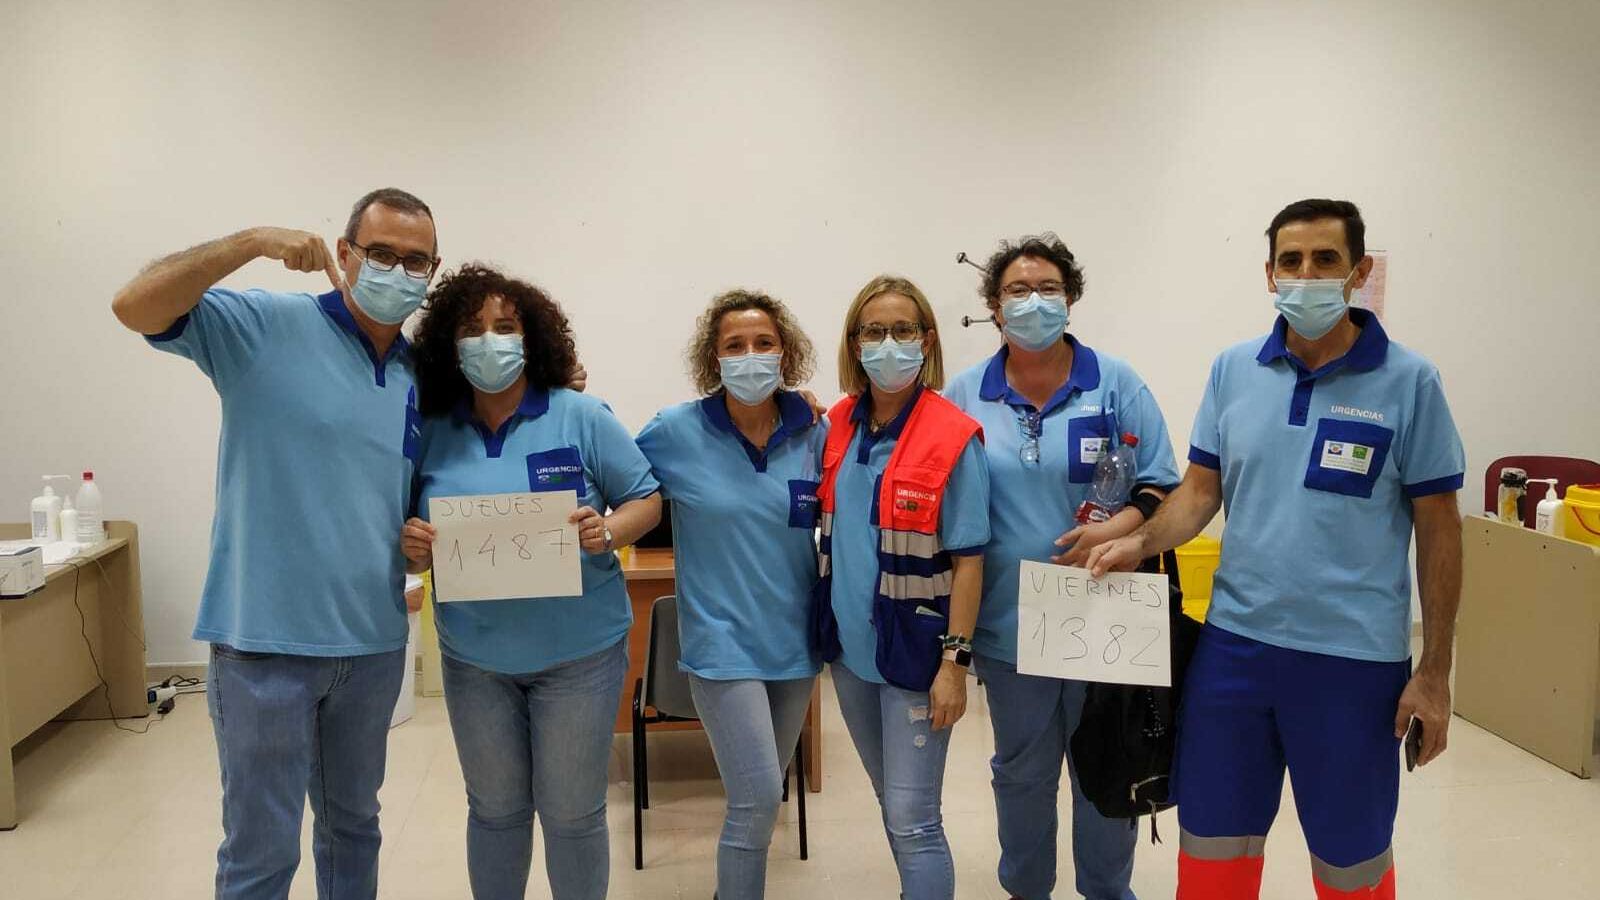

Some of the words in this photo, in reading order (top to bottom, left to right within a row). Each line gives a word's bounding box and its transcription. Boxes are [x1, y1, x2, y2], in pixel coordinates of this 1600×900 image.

[1330, 405, 1384, 422] URGENCIAS
[448, 528, 573, 572] 1487
[1030, 570, 1163, 608] VIERNES
[1031, 610, 1162, 668] 1382
